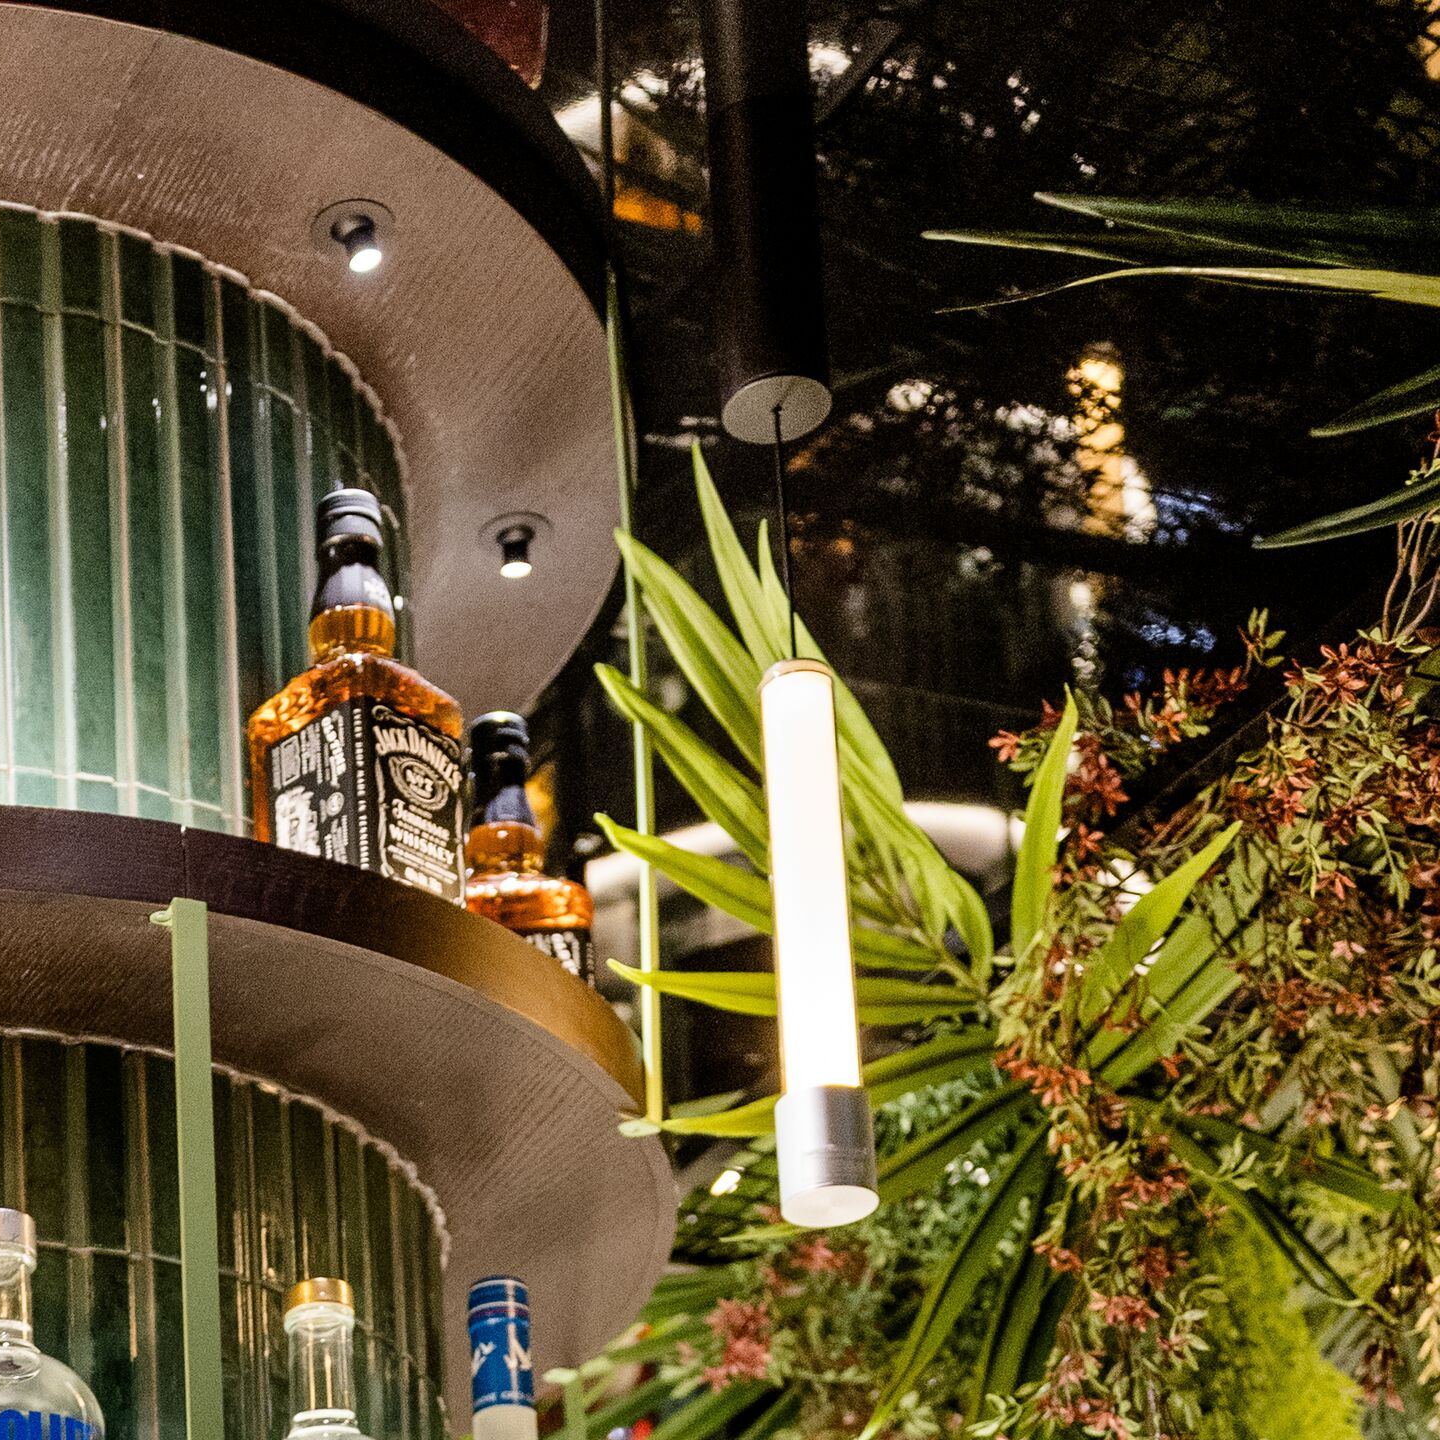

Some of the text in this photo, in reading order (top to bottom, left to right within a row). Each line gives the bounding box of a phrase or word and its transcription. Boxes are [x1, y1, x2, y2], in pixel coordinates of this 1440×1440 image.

[373, 725, 462, 794] JACK DANIEL'S
[389, 823, 456, 866] WHISKEY
